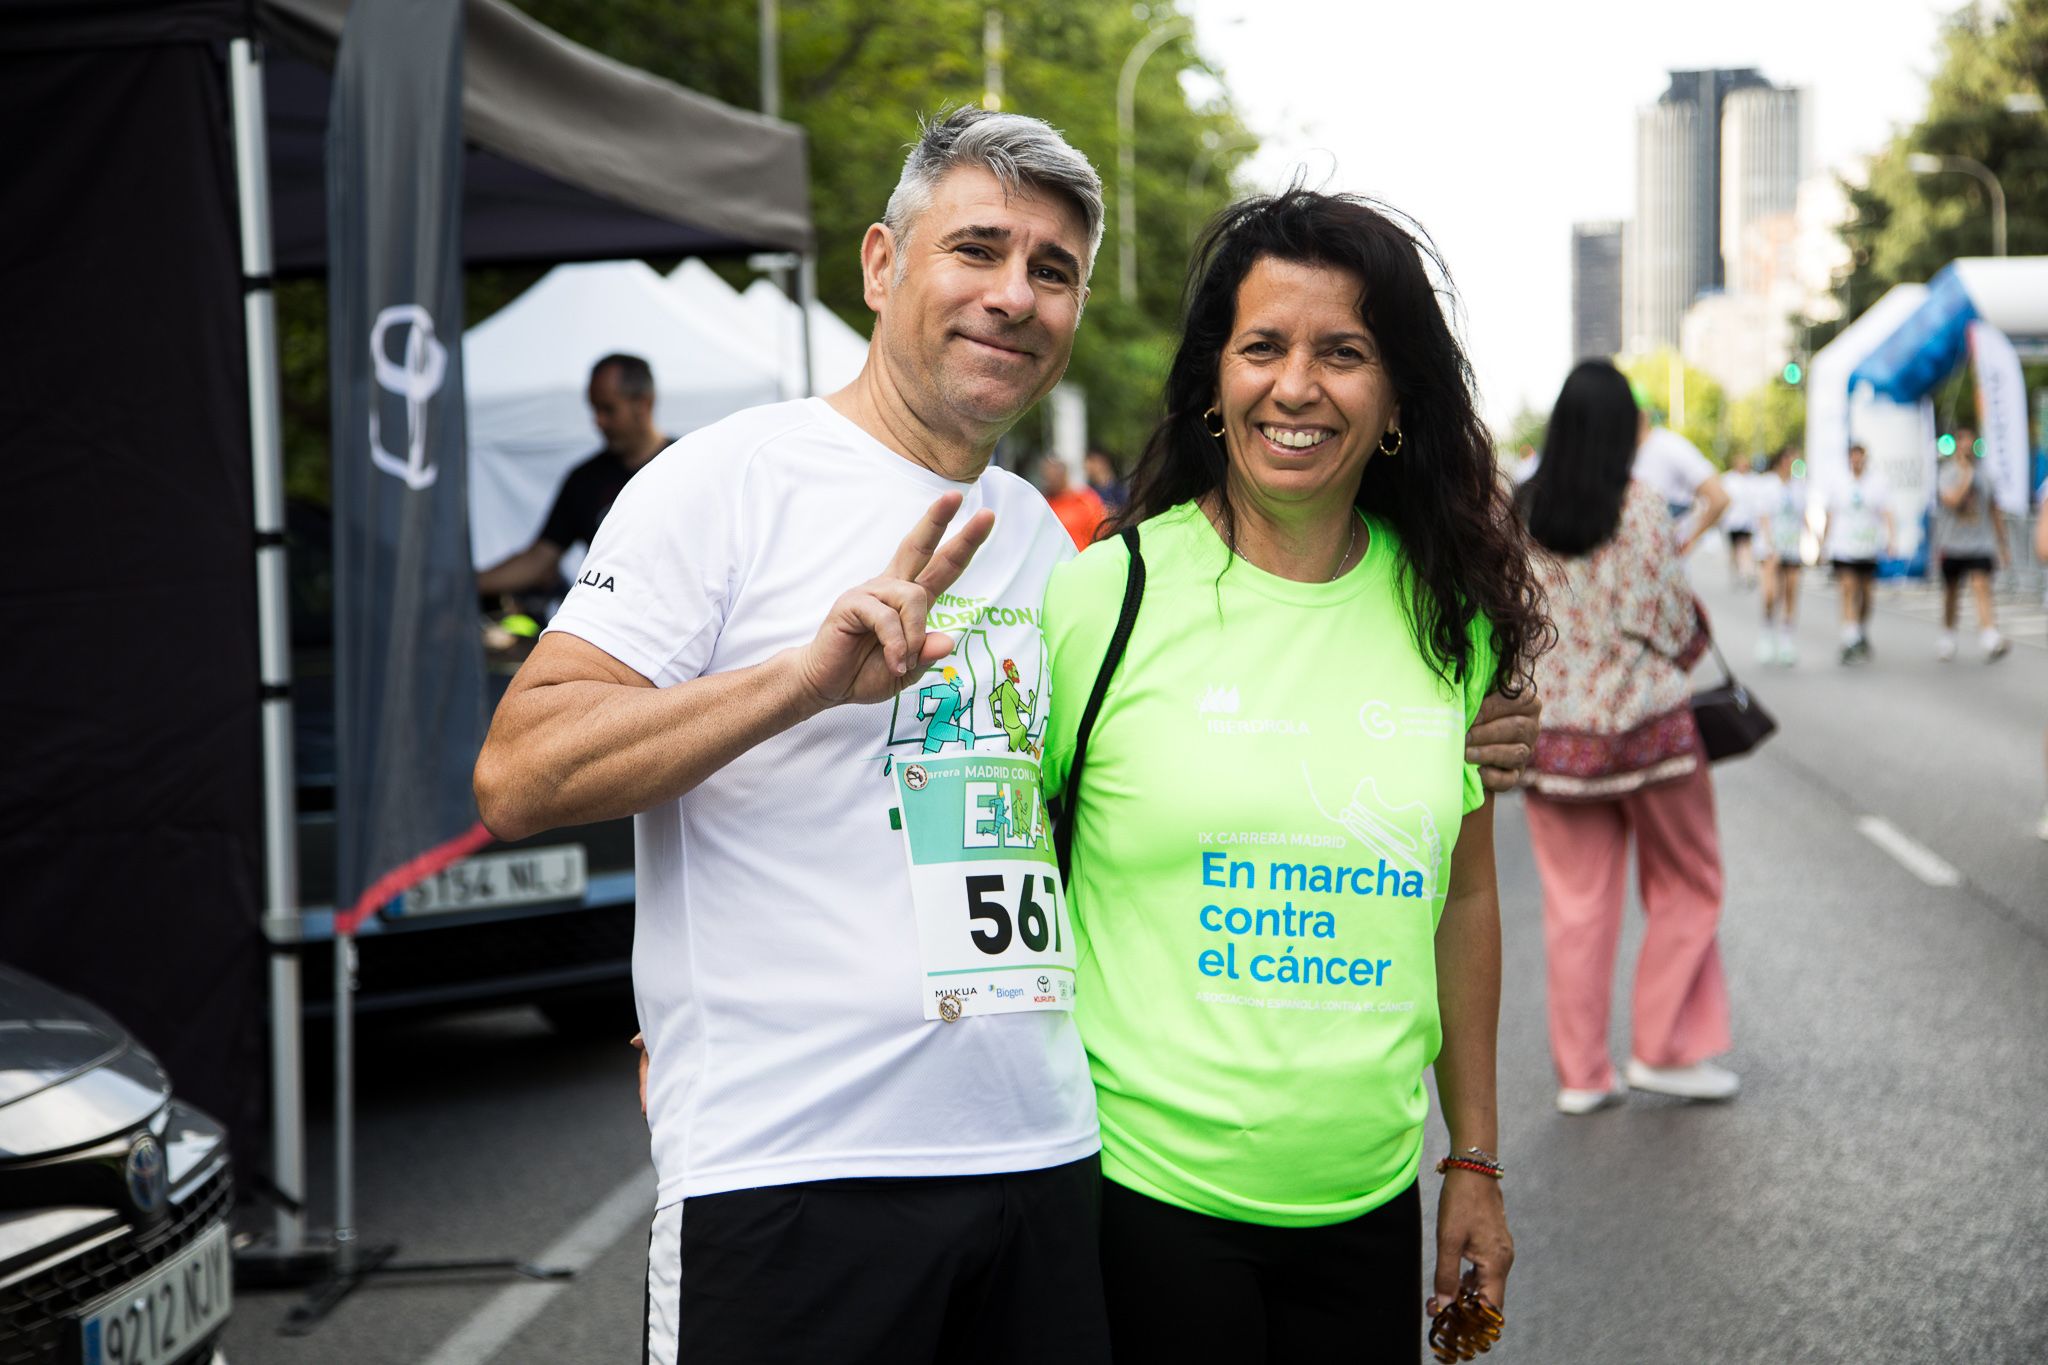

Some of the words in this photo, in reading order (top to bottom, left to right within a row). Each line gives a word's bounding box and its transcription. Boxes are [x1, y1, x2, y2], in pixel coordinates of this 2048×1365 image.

[575, 570, 615, 592] UA
[987, 606, 1034, 626] CON
[928, 768, 960, 780] arrera
[964, 765, 1009, 780] MADRID
[1011, 767, 1030, 781] CON
[1216, 831, 1286, 847] CARRERA
[1290, 833, 1348, 849] MADRID
[1202, 851, 1255, 889] En
[1269, 858, 1424, 899] marcha
[1199, 901, 1336, 939] contra
[1198, 942, 1240, 980] el
[1249, 945, 1392, 987] cáncer
[996, 987, 1024, 999] Biogen
